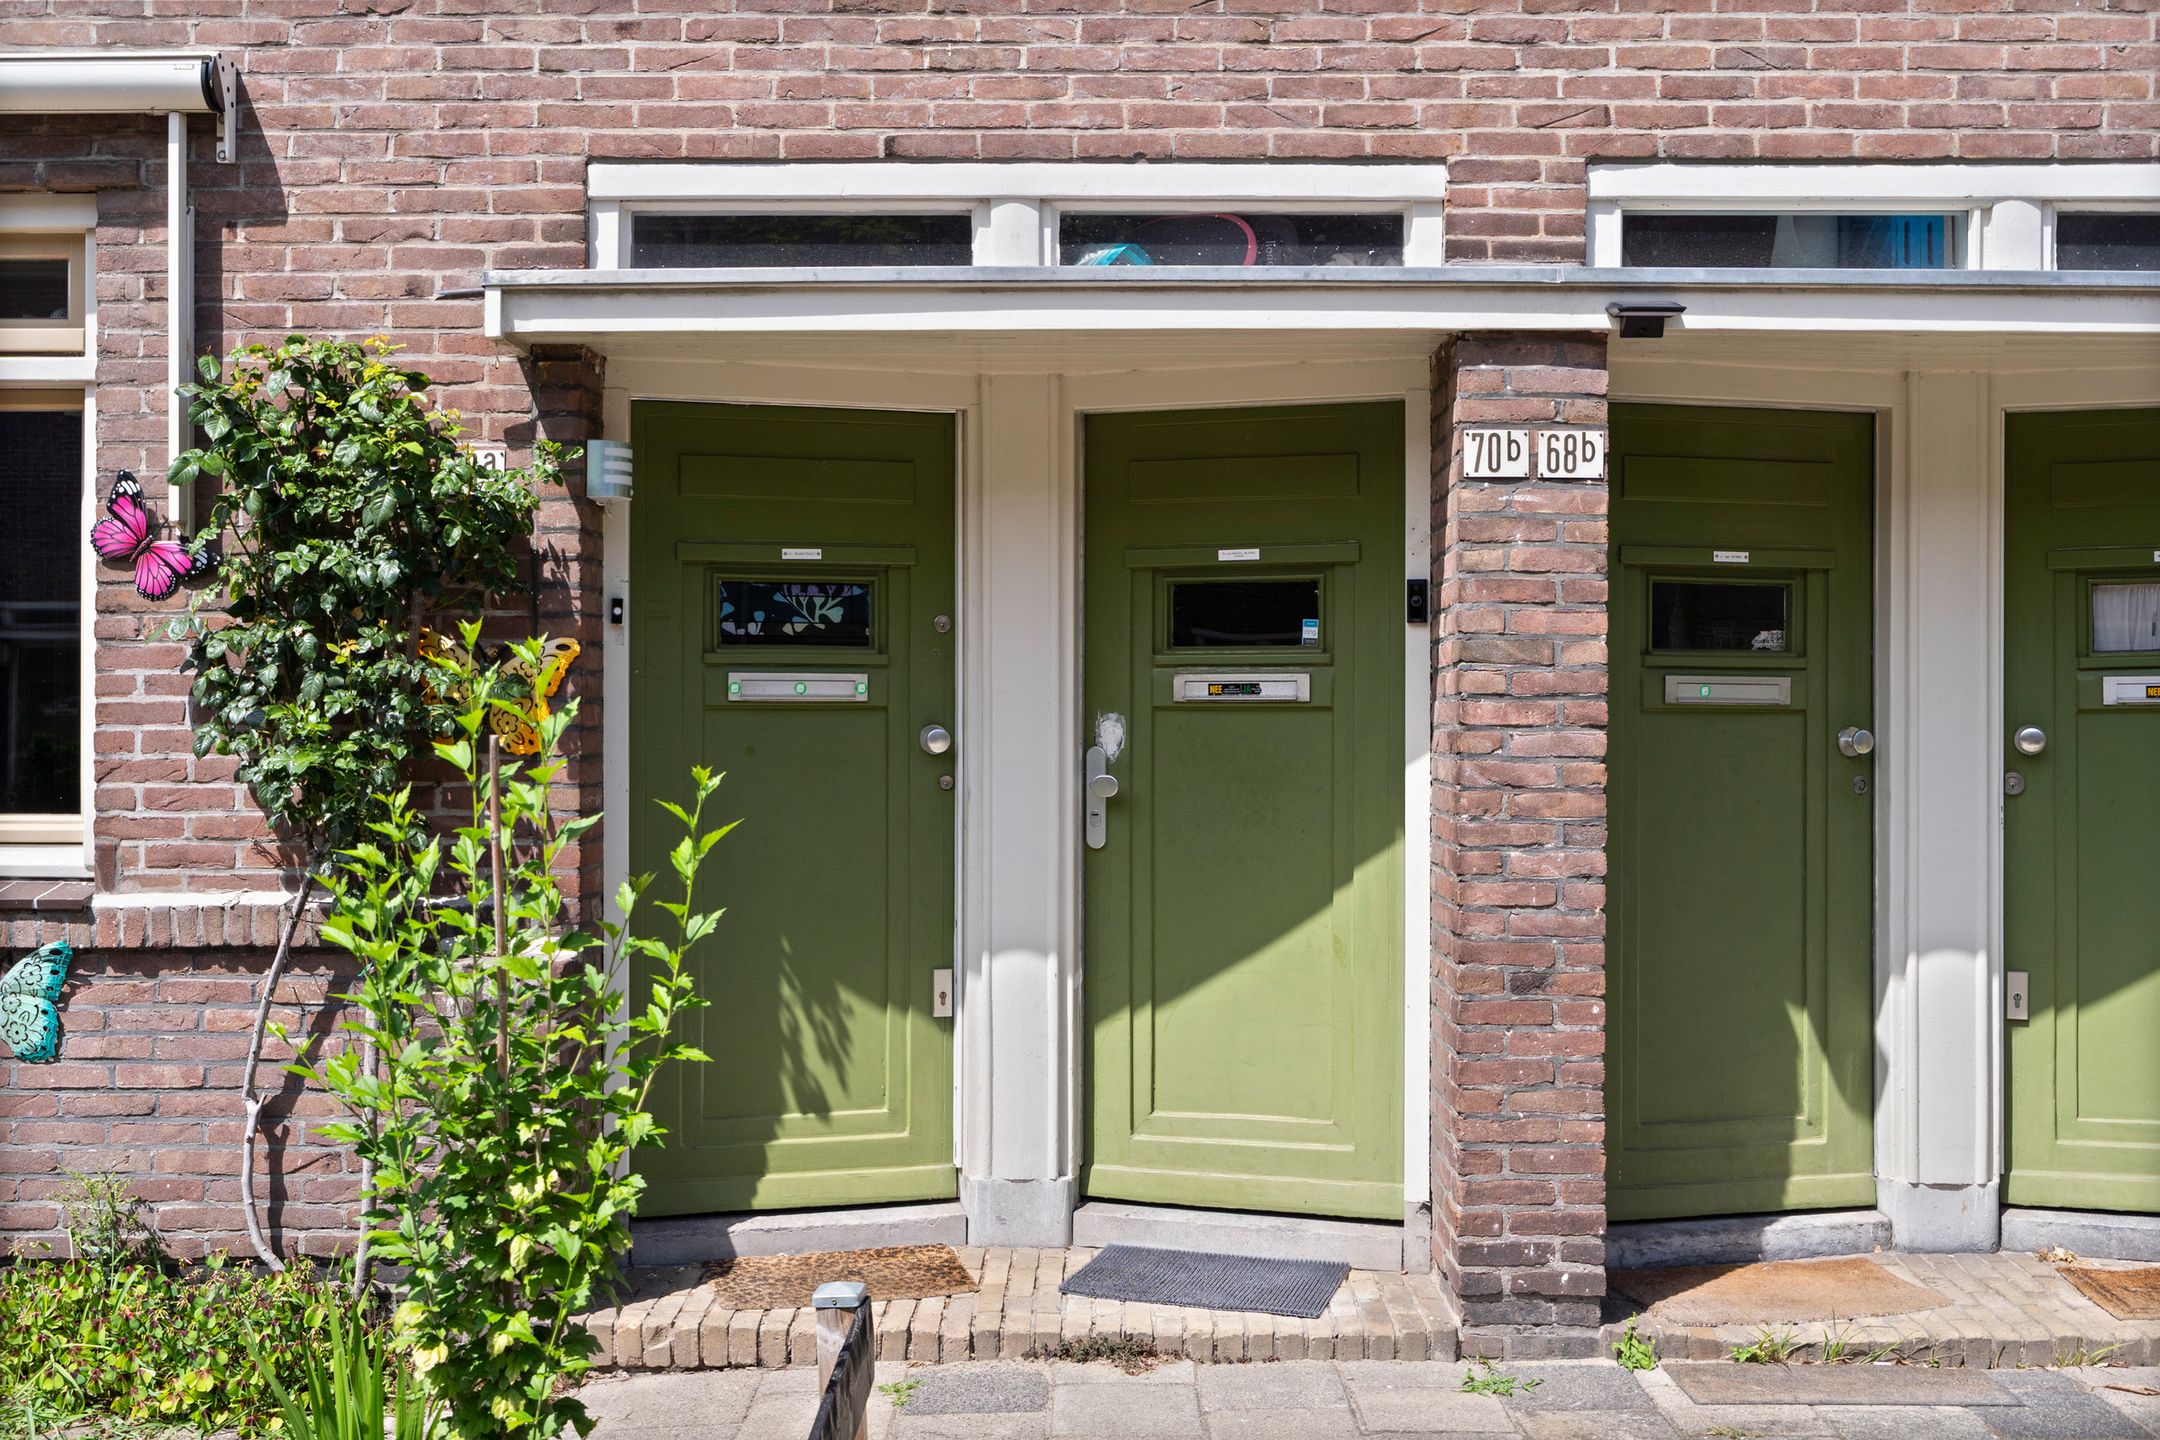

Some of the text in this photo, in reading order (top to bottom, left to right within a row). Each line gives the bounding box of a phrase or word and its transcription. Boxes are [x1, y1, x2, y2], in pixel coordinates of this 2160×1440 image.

[1471, 431, 1521, 473] 70b
[1546, 432, 1596, 474] 68b
[1209, 684, 1223, 694] NEE
